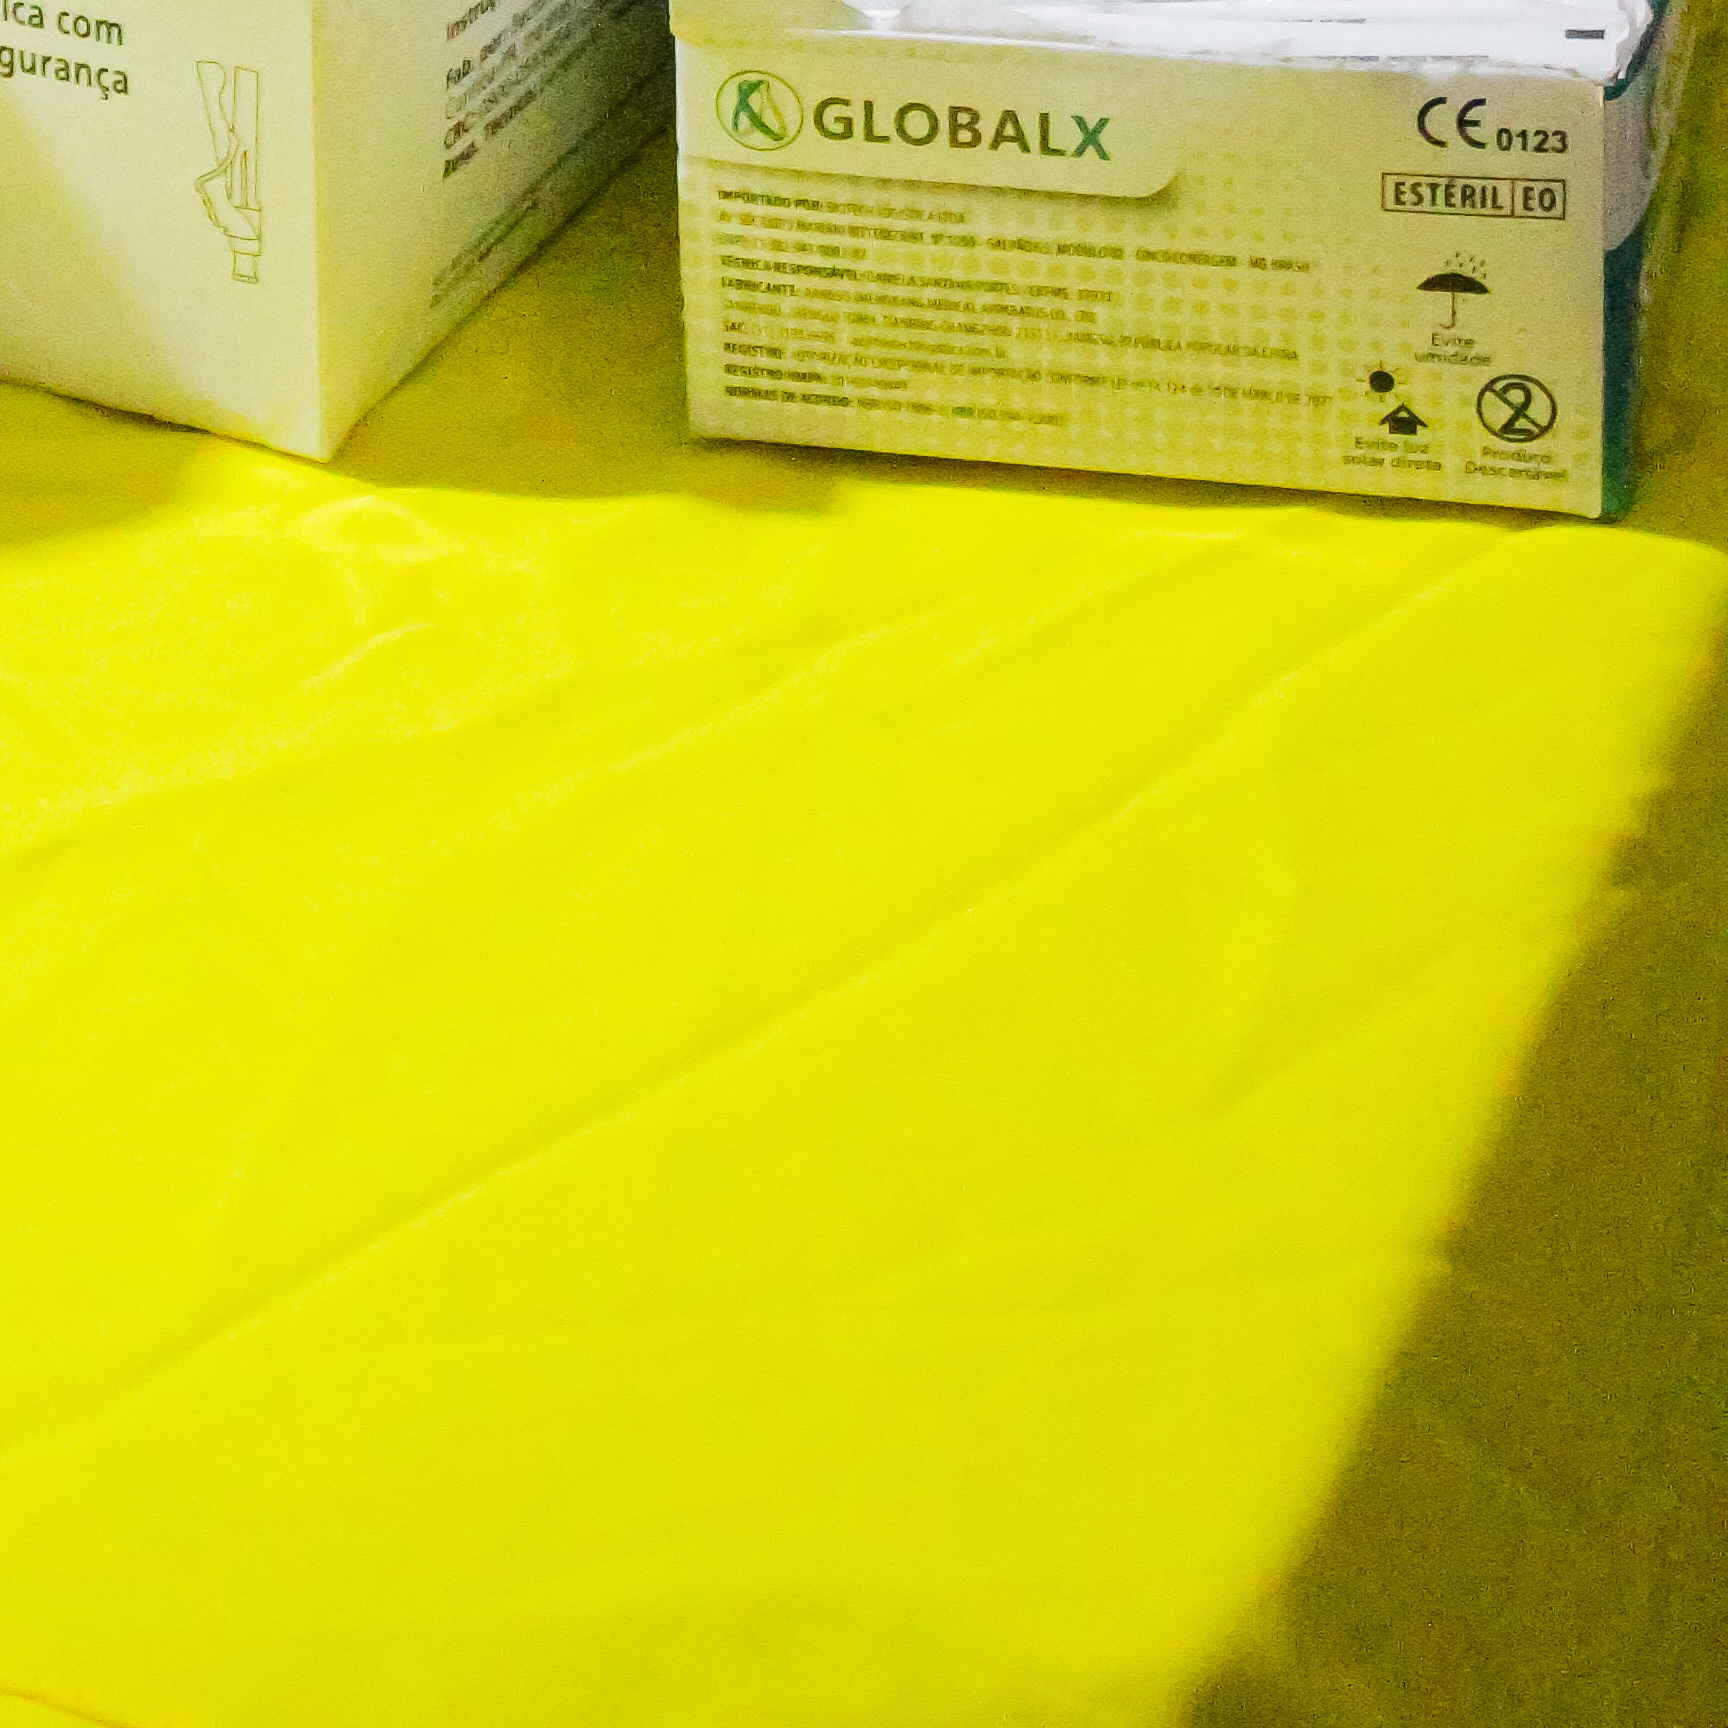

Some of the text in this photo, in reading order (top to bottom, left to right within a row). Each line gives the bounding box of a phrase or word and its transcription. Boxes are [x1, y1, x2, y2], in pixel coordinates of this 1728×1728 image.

[57, 11, 124, 46] com
[812, 96, 1111, 161] GLOBALX
[1496, 127, 1569, 154] 0123
[1393, 177, 1558, 212] ESTÉRIL EO
[1431, 332, 1475, 347] Evite
[1355, 436, 1430, 454] Evite luz
[1343, 454, 1386, 467] solar
